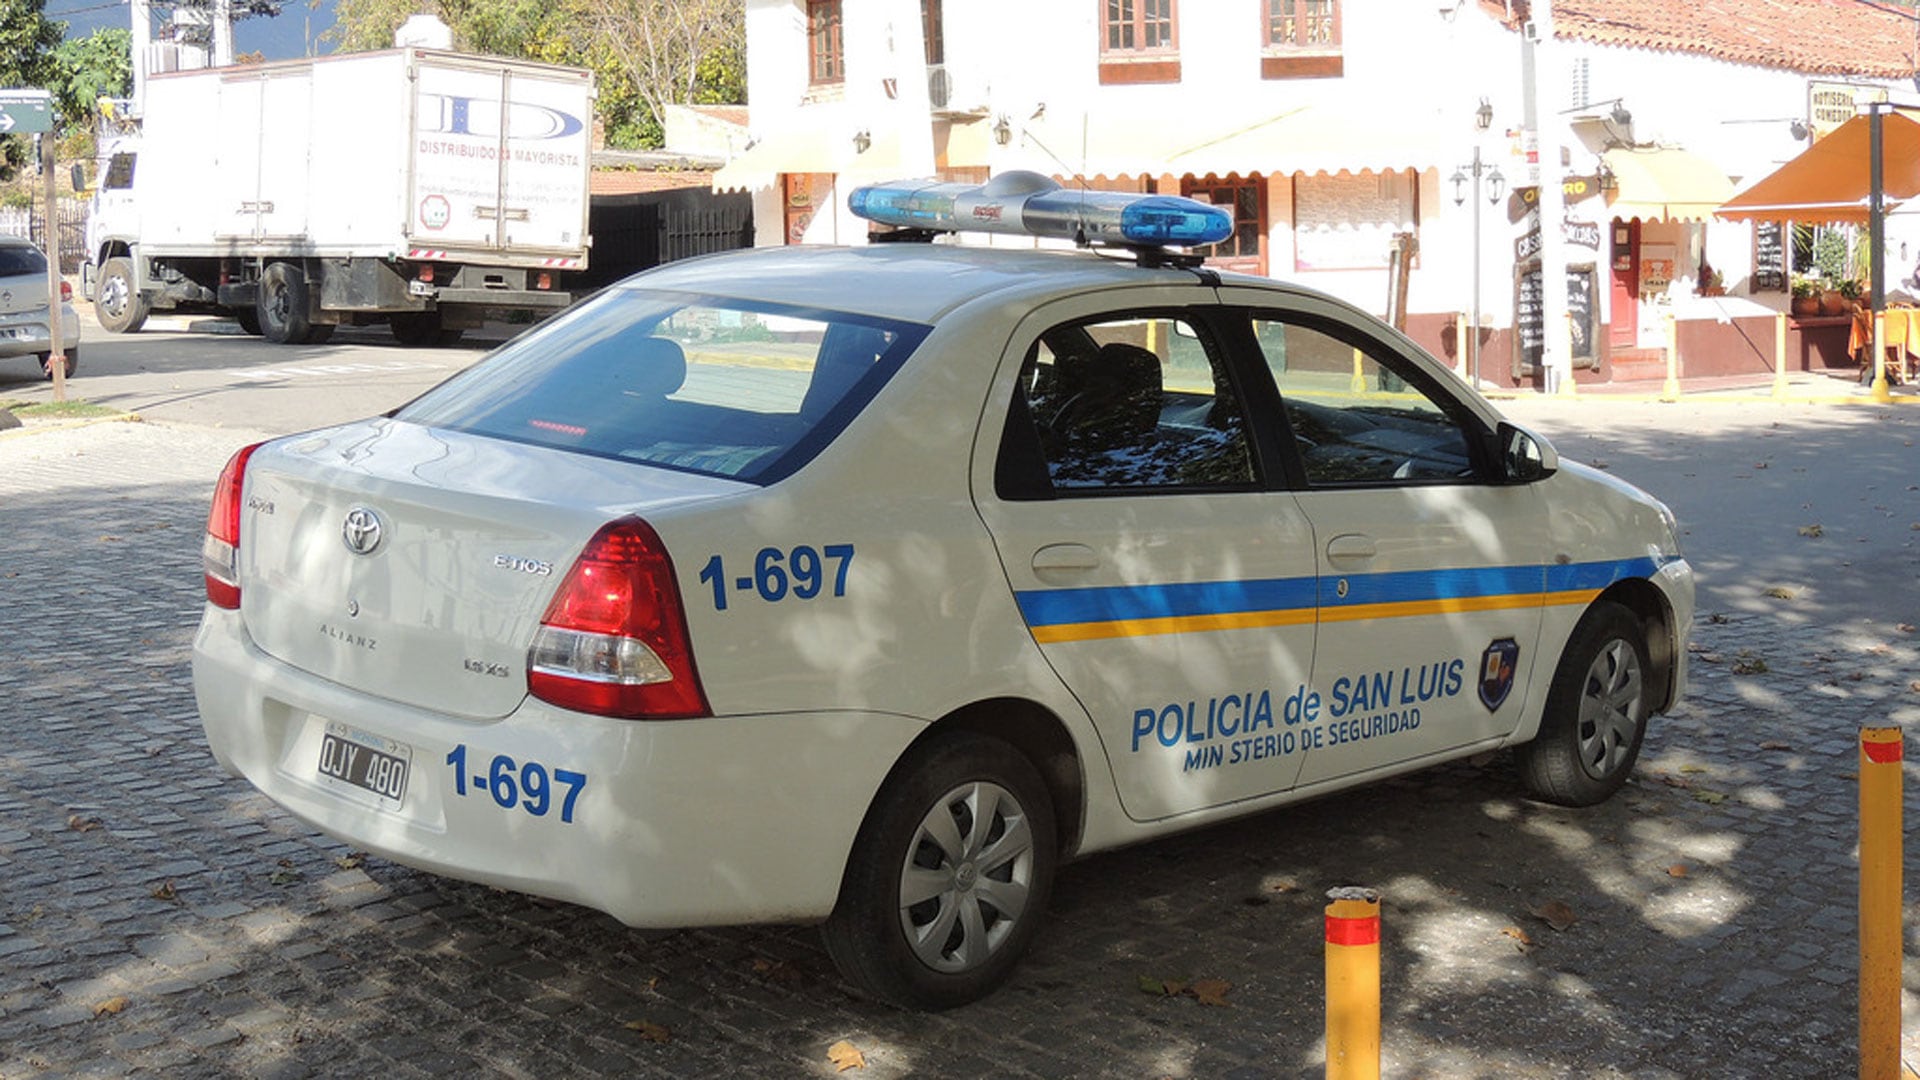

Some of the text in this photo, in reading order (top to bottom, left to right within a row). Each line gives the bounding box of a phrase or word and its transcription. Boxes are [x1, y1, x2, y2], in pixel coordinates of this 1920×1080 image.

[1815, 107, 1852, 122] COMEDOR
[515, 150, 580, 167] MAYORISTA
[494, 554, 553, 577] ETIOS
[699, 544, 855, 611] 1-697
[319, 623, 377, 650] ALIANZ
[1131, 658, 1464, 752] POLICIA de SAN LUIS
[1301, 726, 1323, 751] DE
[1328, 707, 1421, 746] SEGURIDAD
[320, 737, 359, 781] OJY
[365, 753, 404, 798] 480
[446, 743, 587, 824] 1-697
